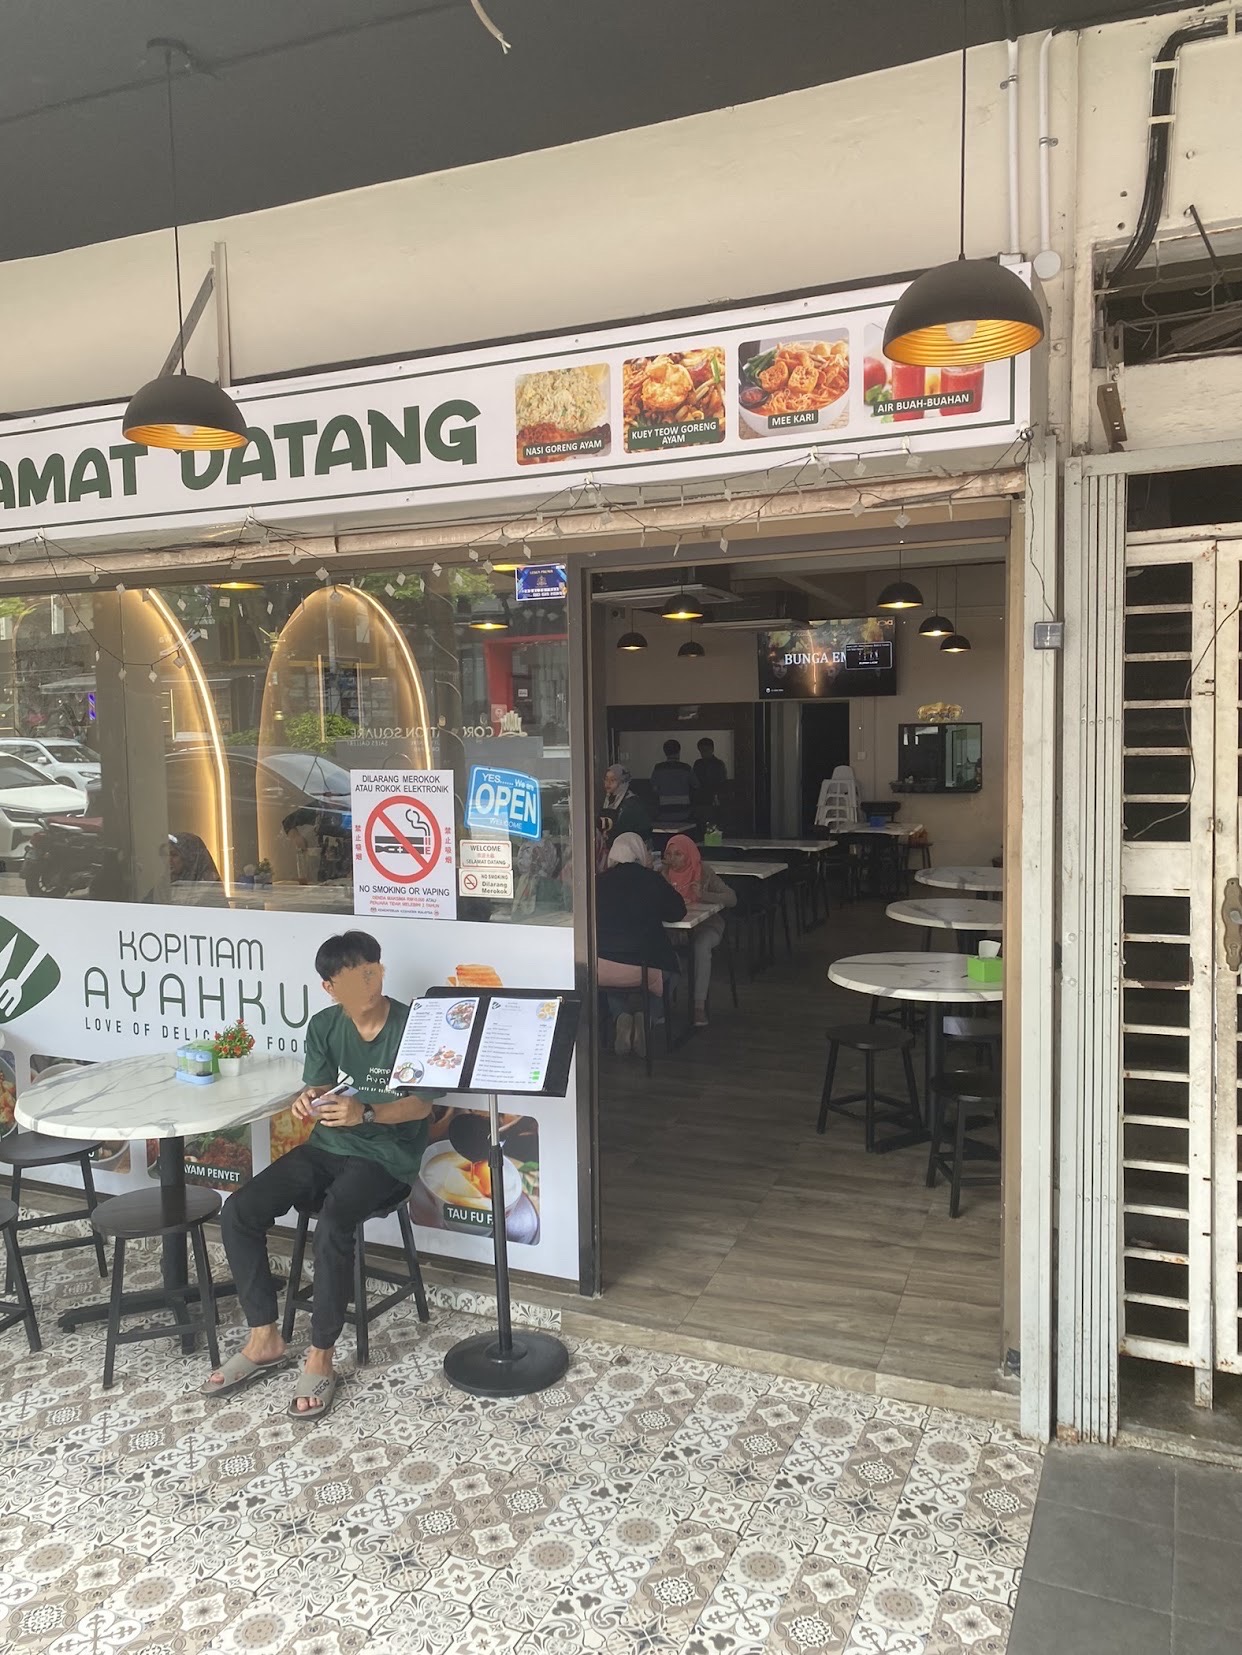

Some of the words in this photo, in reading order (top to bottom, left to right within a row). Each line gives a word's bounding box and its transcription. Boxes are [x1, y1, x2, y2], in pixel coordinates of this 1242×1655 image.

[877, 403, 894, 413] AIR
[896, 394, 970, 411] BUAH-BUAHAN
[771, 415, 792, 426] MEE
[793, 413, 815, 424] KARI
[631, 430, 653, 440] KUEY
[654, 426, 679, 437] TEOW
[680, 421, 717, 433] GORENG
[173, 399, 481, 491] DATANG
[662, 434, 686, 445] AYAM
[525, 446, 544, 456] NASI
[545, 443, 578, 454] GORENG
[580, 440, 603, 450] AYAM
[784, 653, 829, 665] BUNGA
[362, 775, 399, 783] DILARANG
[402, 775, 440, 783] MEROKOK
[355, 784, 373, 792] ATAU
[375, 784, 400, 793] ROKOK
[403, 785, 449, 793] ELEKTRONIK
[475, 782, 536, 825] OPEN
[490, 818, 522, 830] WELCOME
[359, 885, 370, 893] NO
[372, 885, 406, 895] SMOKING
[408, 887, 420, 896] OR
[422, 887, 450, 896] VAPING
[119, 930, 264, 971] KOPITIAM
[84, 966, 309, 1029] AYAHKU
[85, 1016, 122, 1034] LOVE
[133, 1021, 151, 1037] OF
[207, 1168, 241, 1182] PENYET
[447, 1207, 468, 1221] TAU
[470, 1211, 485, 1223] FU
